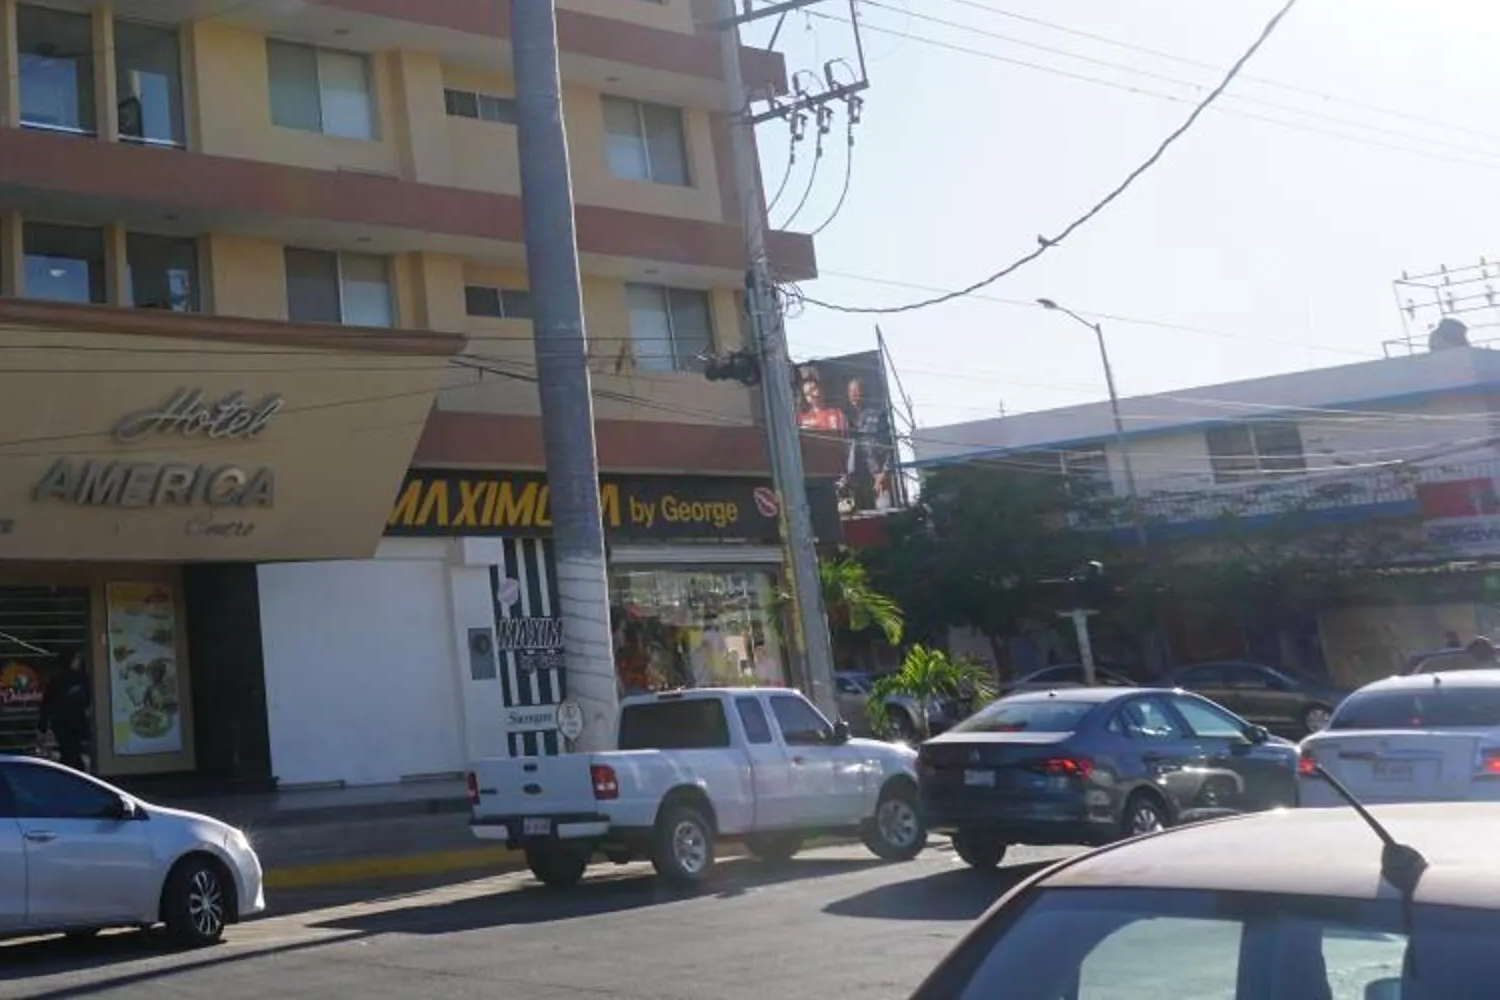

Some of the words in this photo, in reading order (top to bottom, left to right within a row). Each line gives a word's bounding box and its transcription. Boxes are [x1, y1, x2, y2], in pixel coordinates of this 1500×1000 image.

[112, 386, 285, 444] Hotel
[30, 456, 276, 509] AMERICA
[630, 497, 655, 527] by
[661, 496, 739, 528] George
